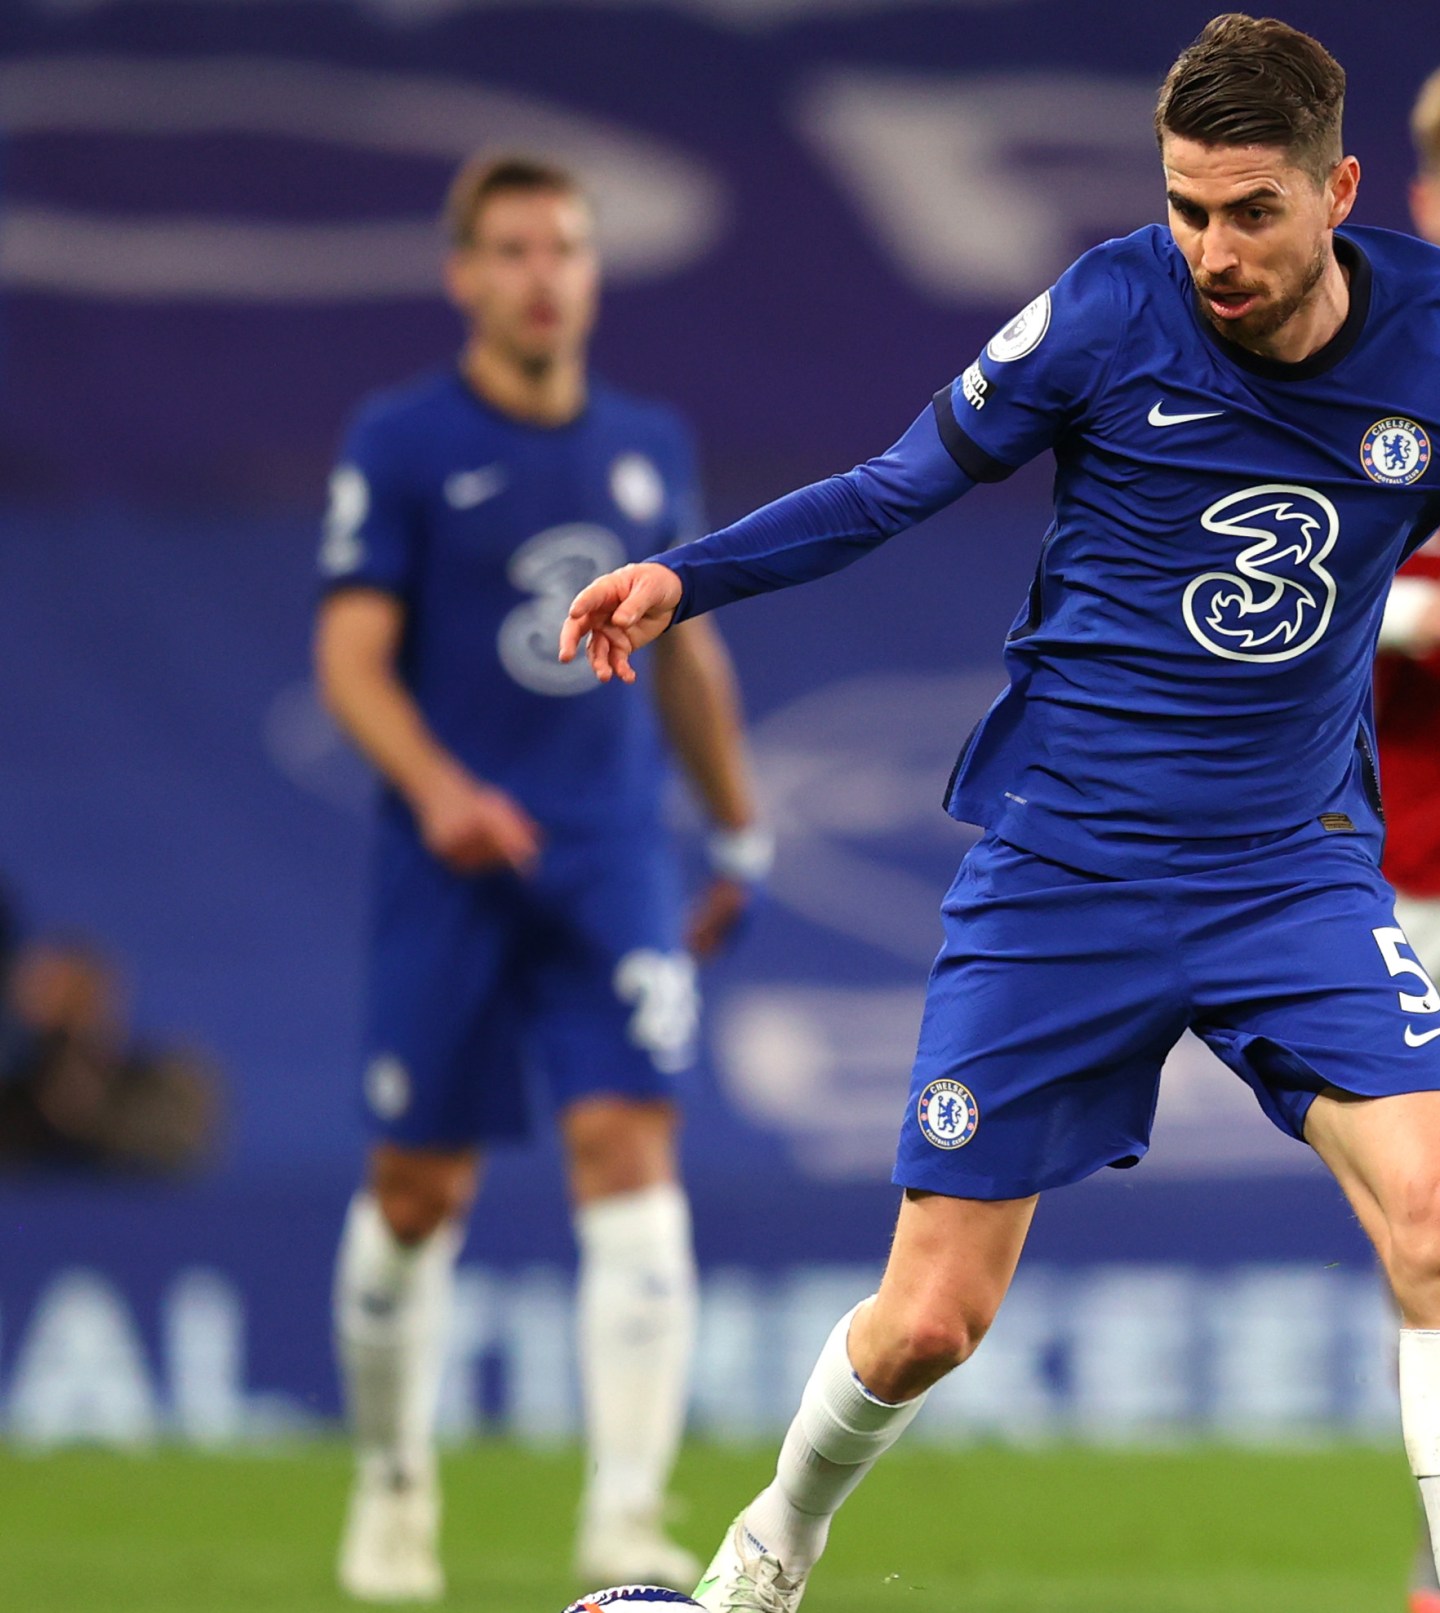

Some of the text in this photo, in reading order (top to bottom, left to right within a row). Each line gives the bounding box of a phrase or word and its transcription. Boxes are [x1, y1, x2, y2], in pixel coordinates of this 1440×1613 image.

[1371, 420, 1417, 436] CHELSEA
[1182, 483, 1340, 663] 3
[929, 1082, 969, 1101] CHELSEA
